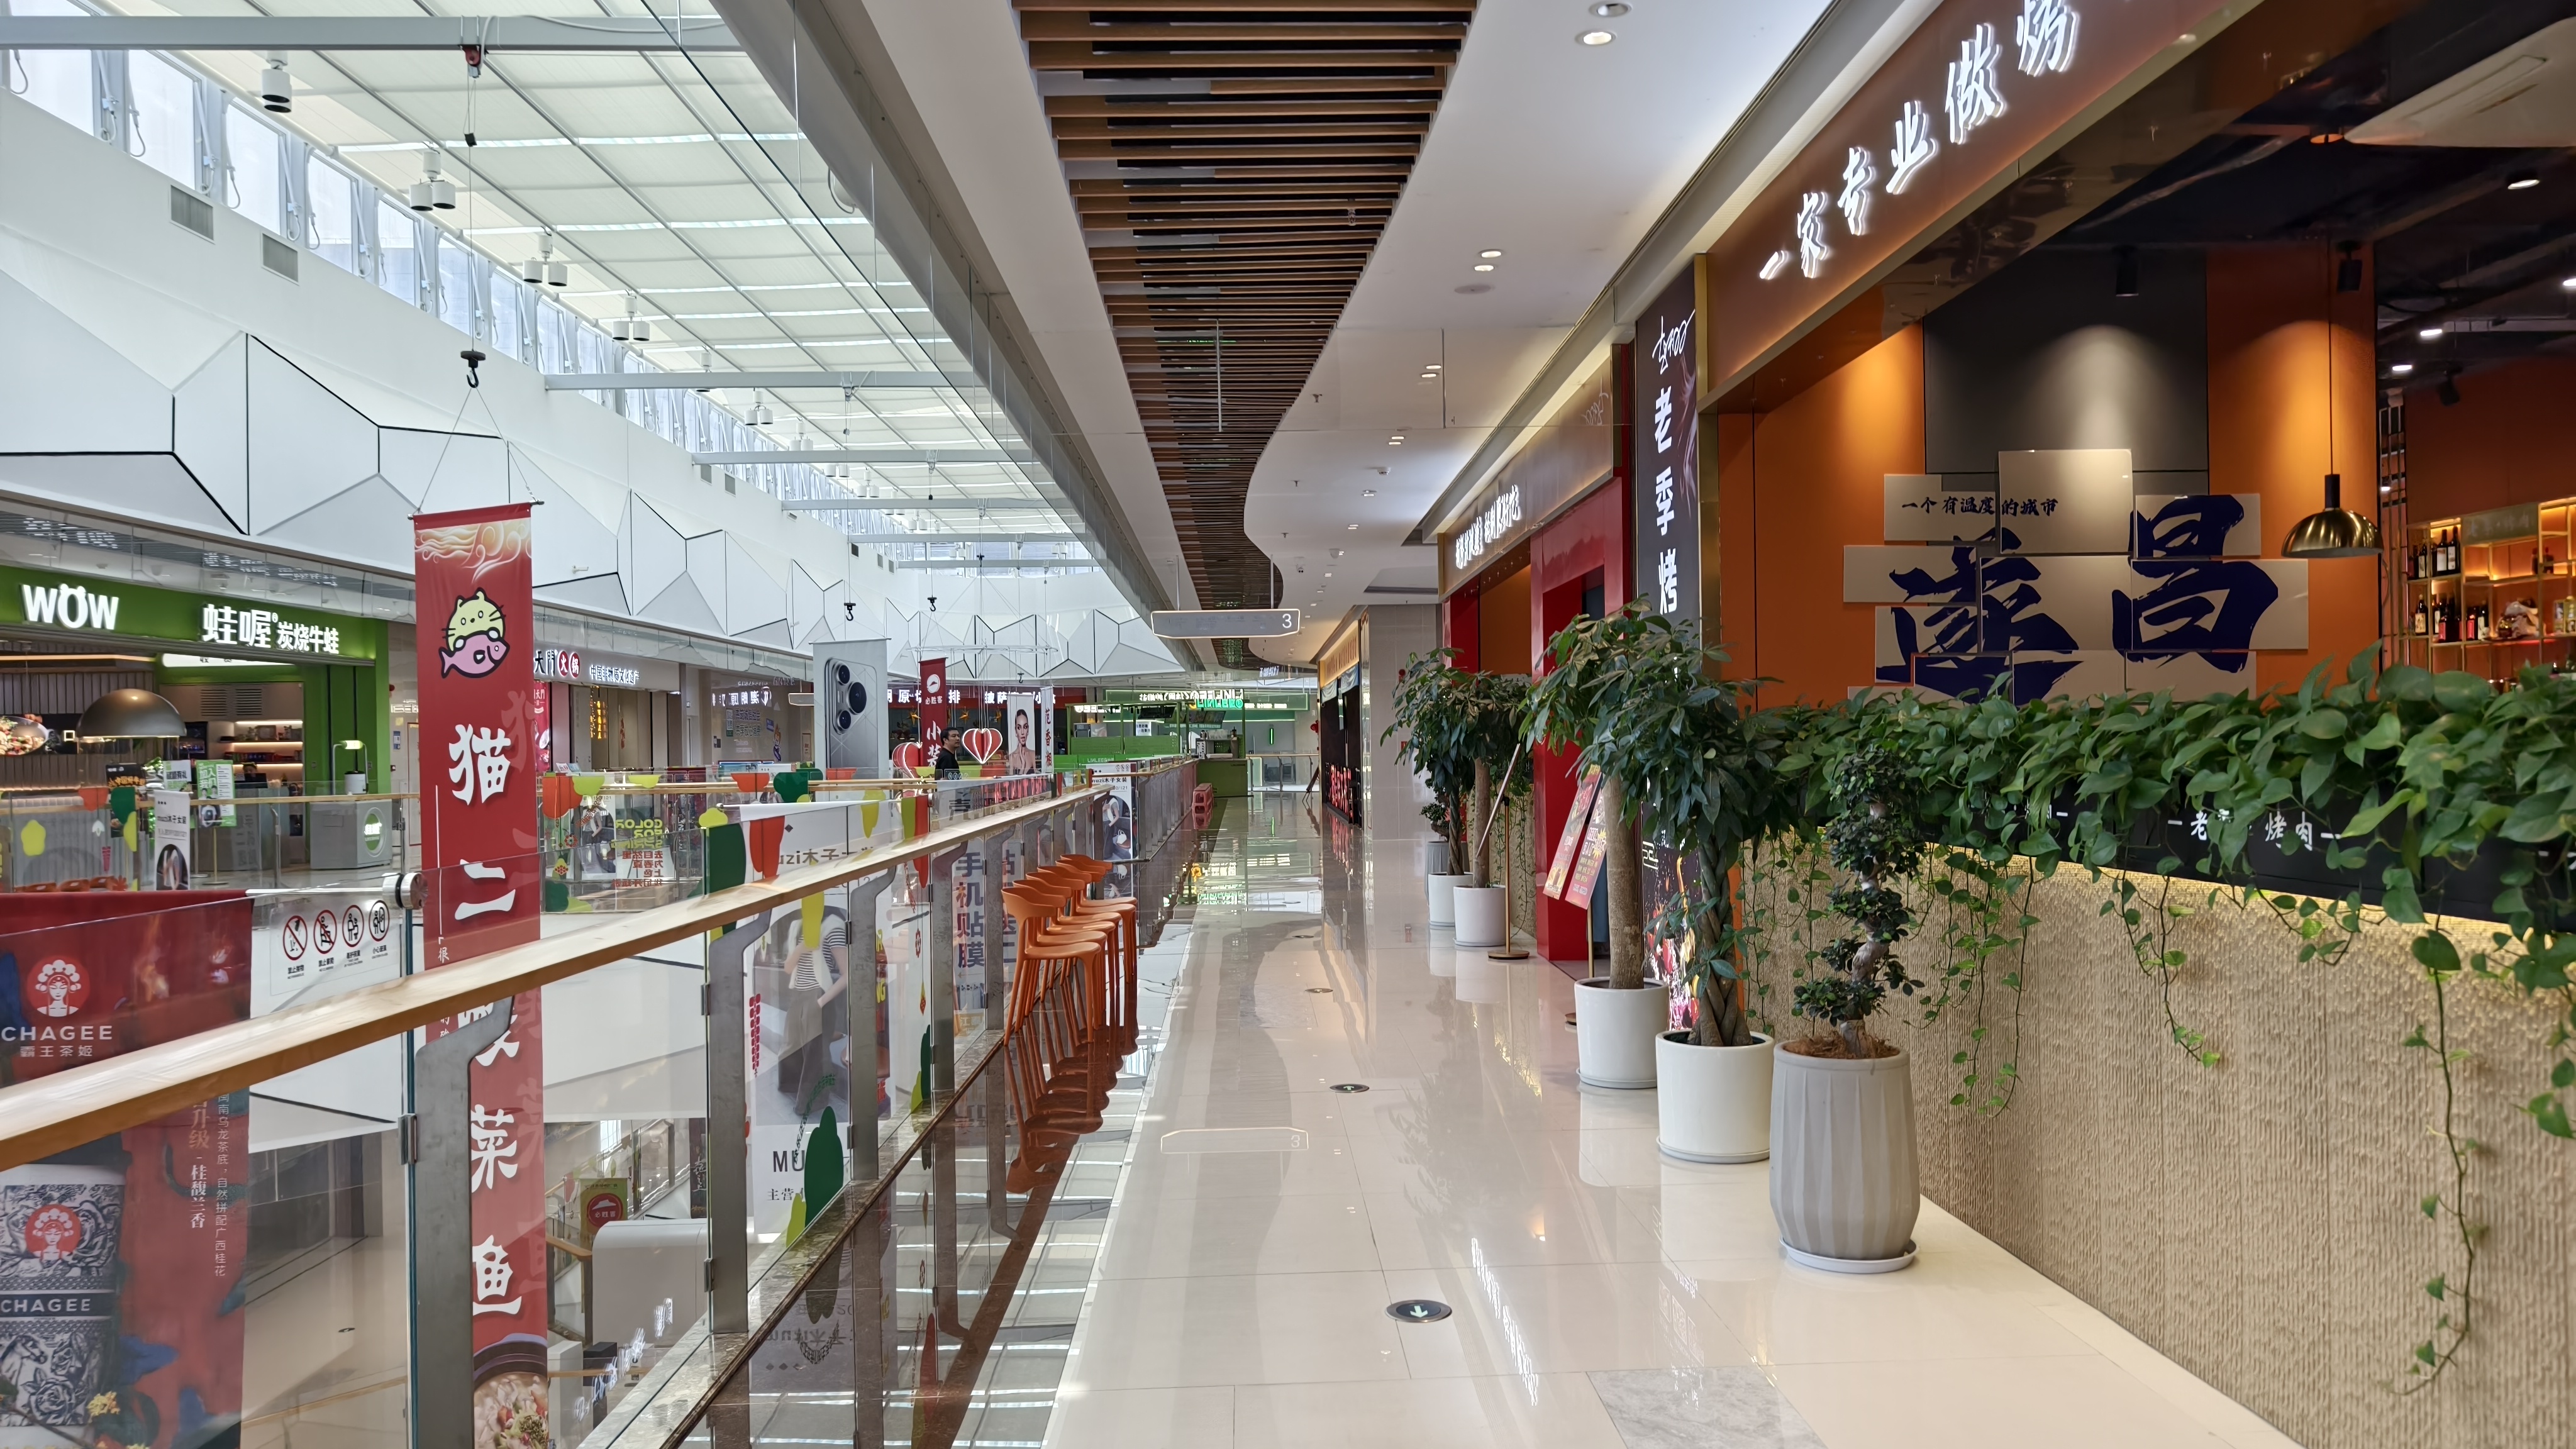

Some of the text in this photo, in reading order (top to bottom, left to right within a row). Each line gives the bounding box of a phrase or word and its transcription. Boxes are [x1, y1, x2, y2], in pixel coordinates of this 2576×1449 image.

[1901, 496, 2059, 516] 一个有温度的城市
[21, 583, 119, 630] WOW
[201, 602, 340, 655] 蛙喔 炭烧牛蛙
[1282, 614, 1292, 628] 3
[2190, 809, 2313, 852] 老烤肉
[1, 1025, 113, 1041] CHAGEE
[19, 1045, 93, 1058] 霸王茶姬
[1, 1297, 91, 1314] CHAGEE
